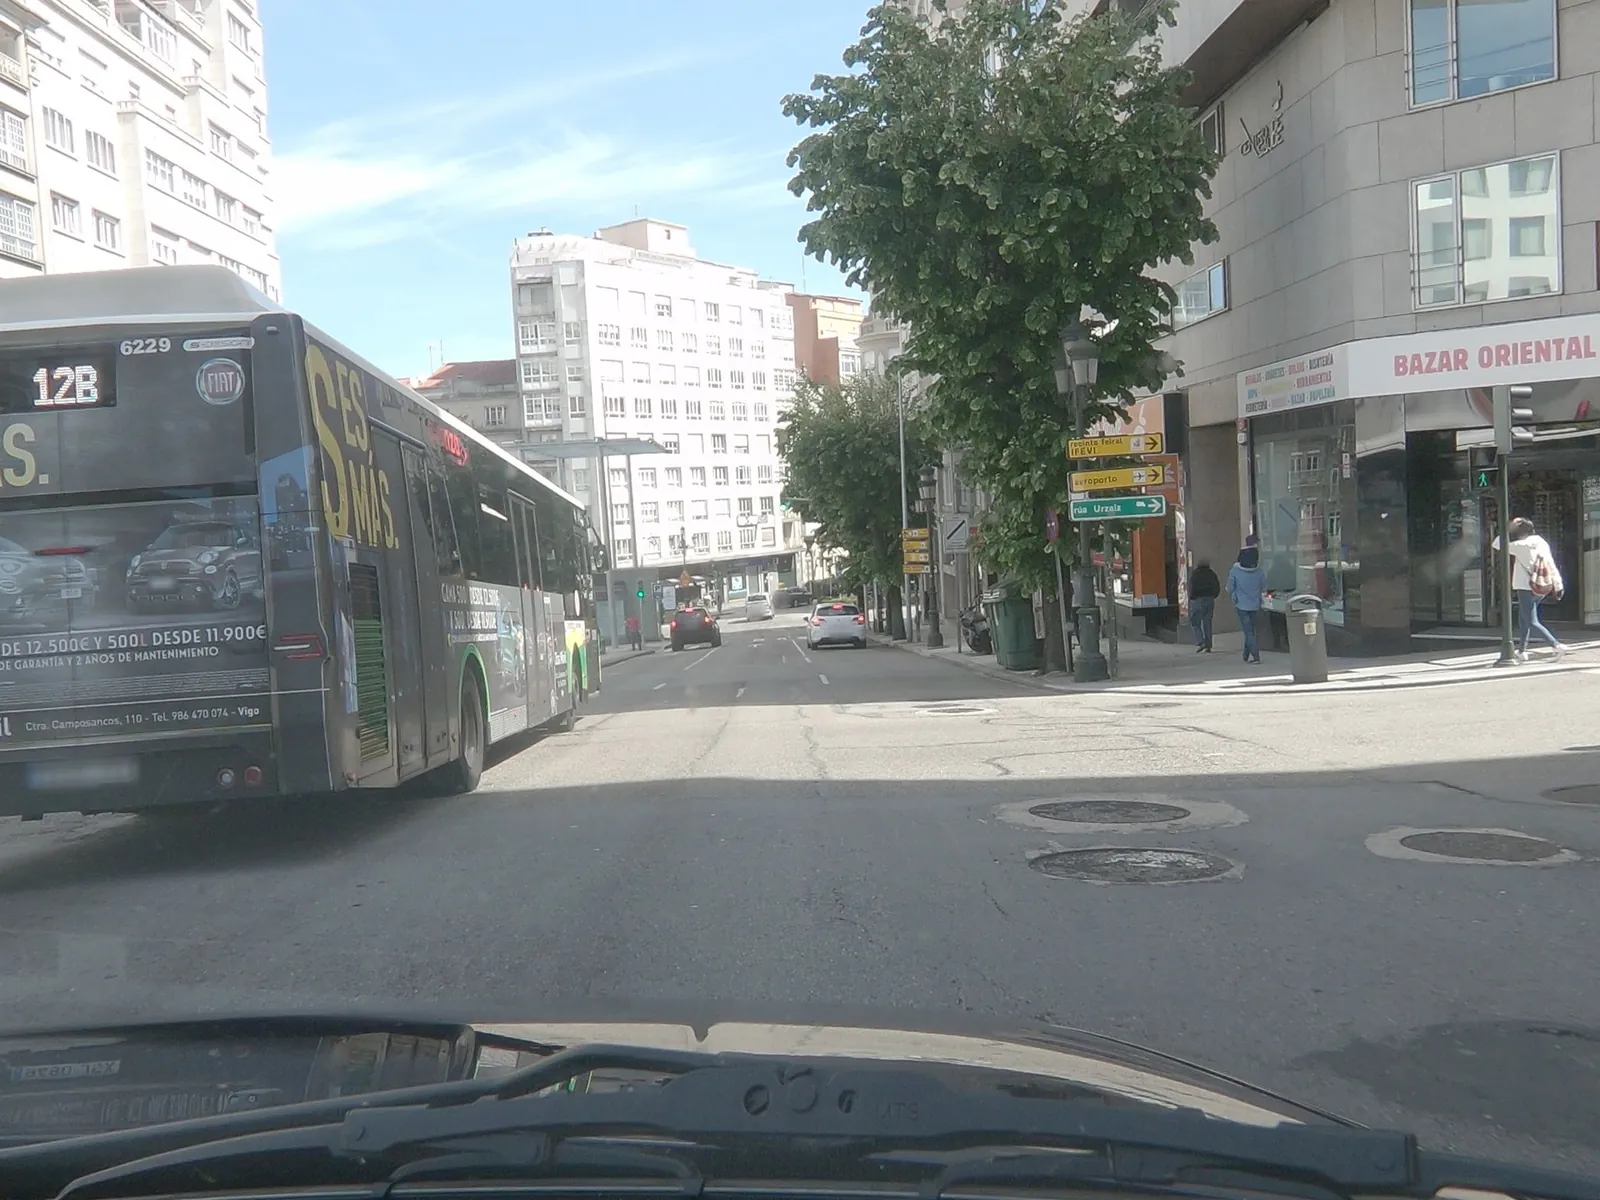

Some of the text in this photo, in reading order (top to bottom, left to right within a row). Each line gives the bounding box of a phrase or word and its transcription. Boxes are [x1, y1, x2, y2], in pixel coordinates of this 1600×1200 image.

[120, 338, 171, 355] 6229
[1394, 335, 1596, 376] BAZAR ORIENTAL
[33, 365, 98, 406] 12B
[207, 371, 235, 392] FIAT
[336, 360, 368, 452] ES
[0, 423, 48, 487] S.
[1070, 437, 1123, 448] recinto feiral
[1071, 448, 1096, 456] IFEVI
[1075, 476, 1117, 486] aeroporto
[349, 450, 399, 549] MÁS.
[1074, 504, 1121, 513] rúa Urzaiz
[2, 625, 267, 657] DE 12.500€ Y 500L DESDE 11.900€
[14, 656, 64, 670] GARANTÍA
[76, 655, 82, 666] 2
[84, 652, 116, 665] AÑOS
[118, 652, 132, 663] DE
[134, 646, 219, 662] MANTENIMIENTO
[25, 721, 49, 732] Ctra.
[52, 717, 123, 729] Camposancos,
[125, 713, 143, 725] 110
[171, 710, 190, 721] 986
[191, 708, 209, 719] 470
[211, 707, 228, 719] 074
[237, 705, 260, 718] Vigo
